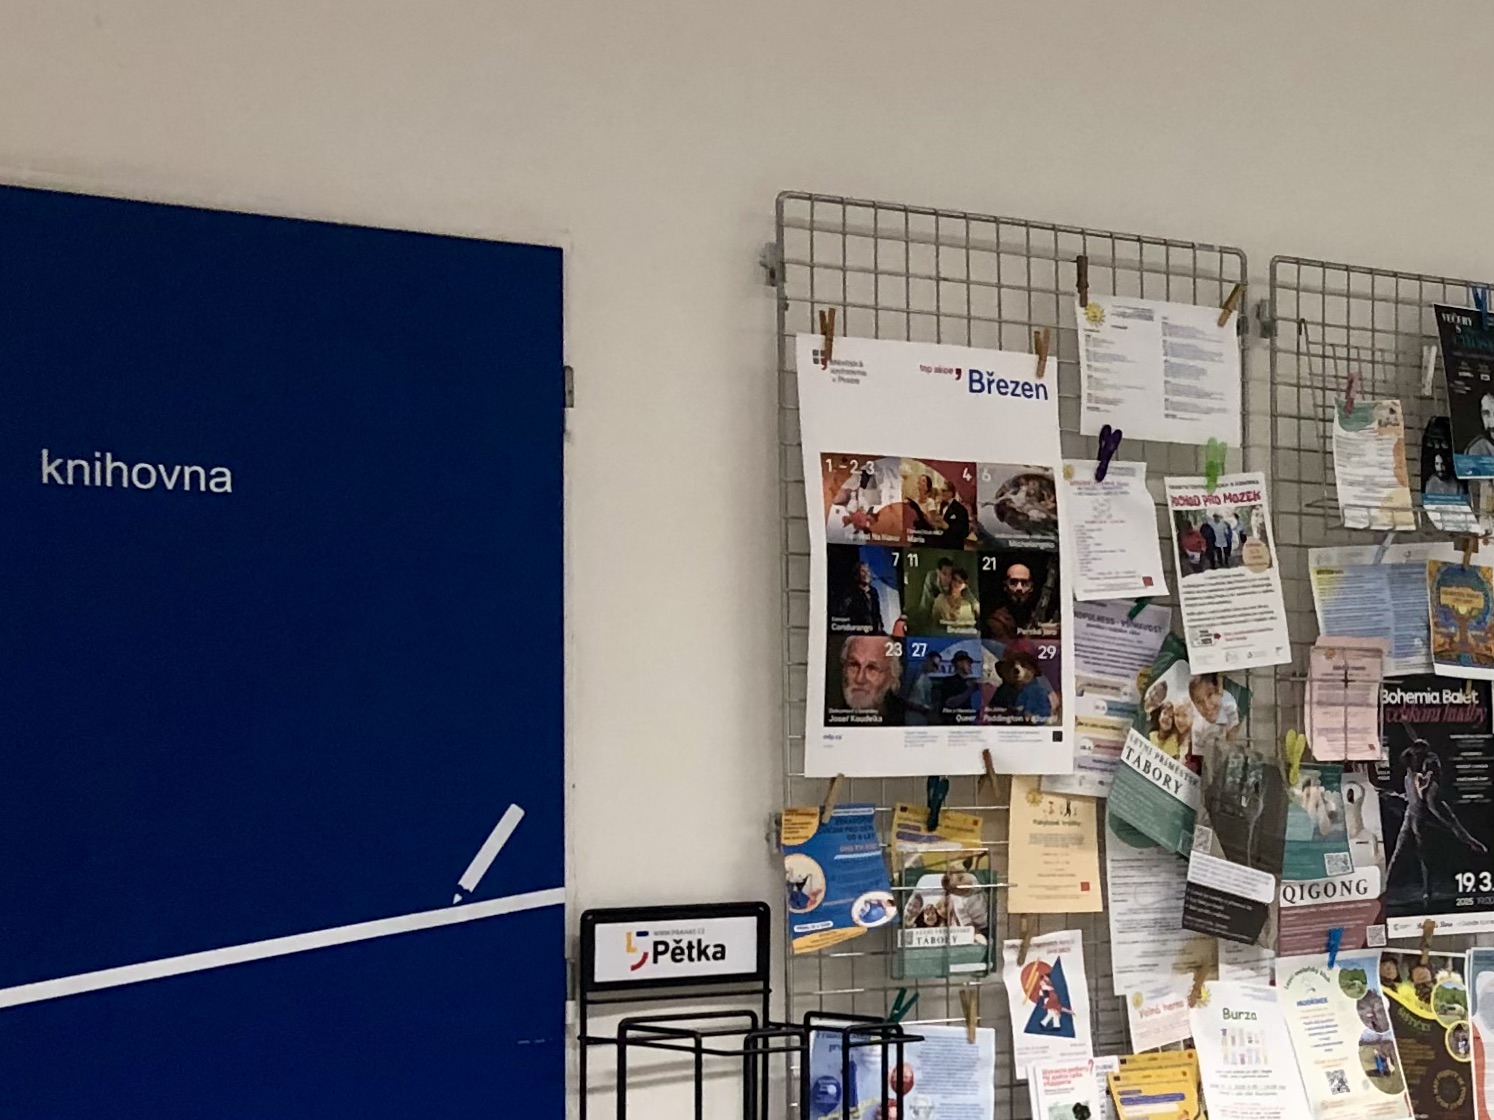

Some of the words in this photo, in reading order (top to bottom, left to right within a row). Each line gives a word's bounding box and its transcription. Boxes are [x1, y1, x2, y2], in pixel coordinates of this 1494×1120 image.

[968, 367, 1048, 401] Březen
[41, 447, 233, 494] knihovna
[962, 467, 973, 482] 4
[981, 468, 993, 483] 6
[1223, 490, 1262, 505] MOZEK
[890, 552, 901, 568] 7
[906, 552, 920, 568] 11
[981, 556, 998, 572] 21
[884, 641, 904, 658] 23
[911, 642, 928, 658] 27
[1037, 644, 1057, 661] 29
[1382, 686, 1442, 706] Bohemia
[1443, 688, 1480, 706] Balet
[1282, 878, 1369, 905] QIGONG
[652, 937, 727, 965] Pětka
[1222, 1006, 1258, 1022] Burza
